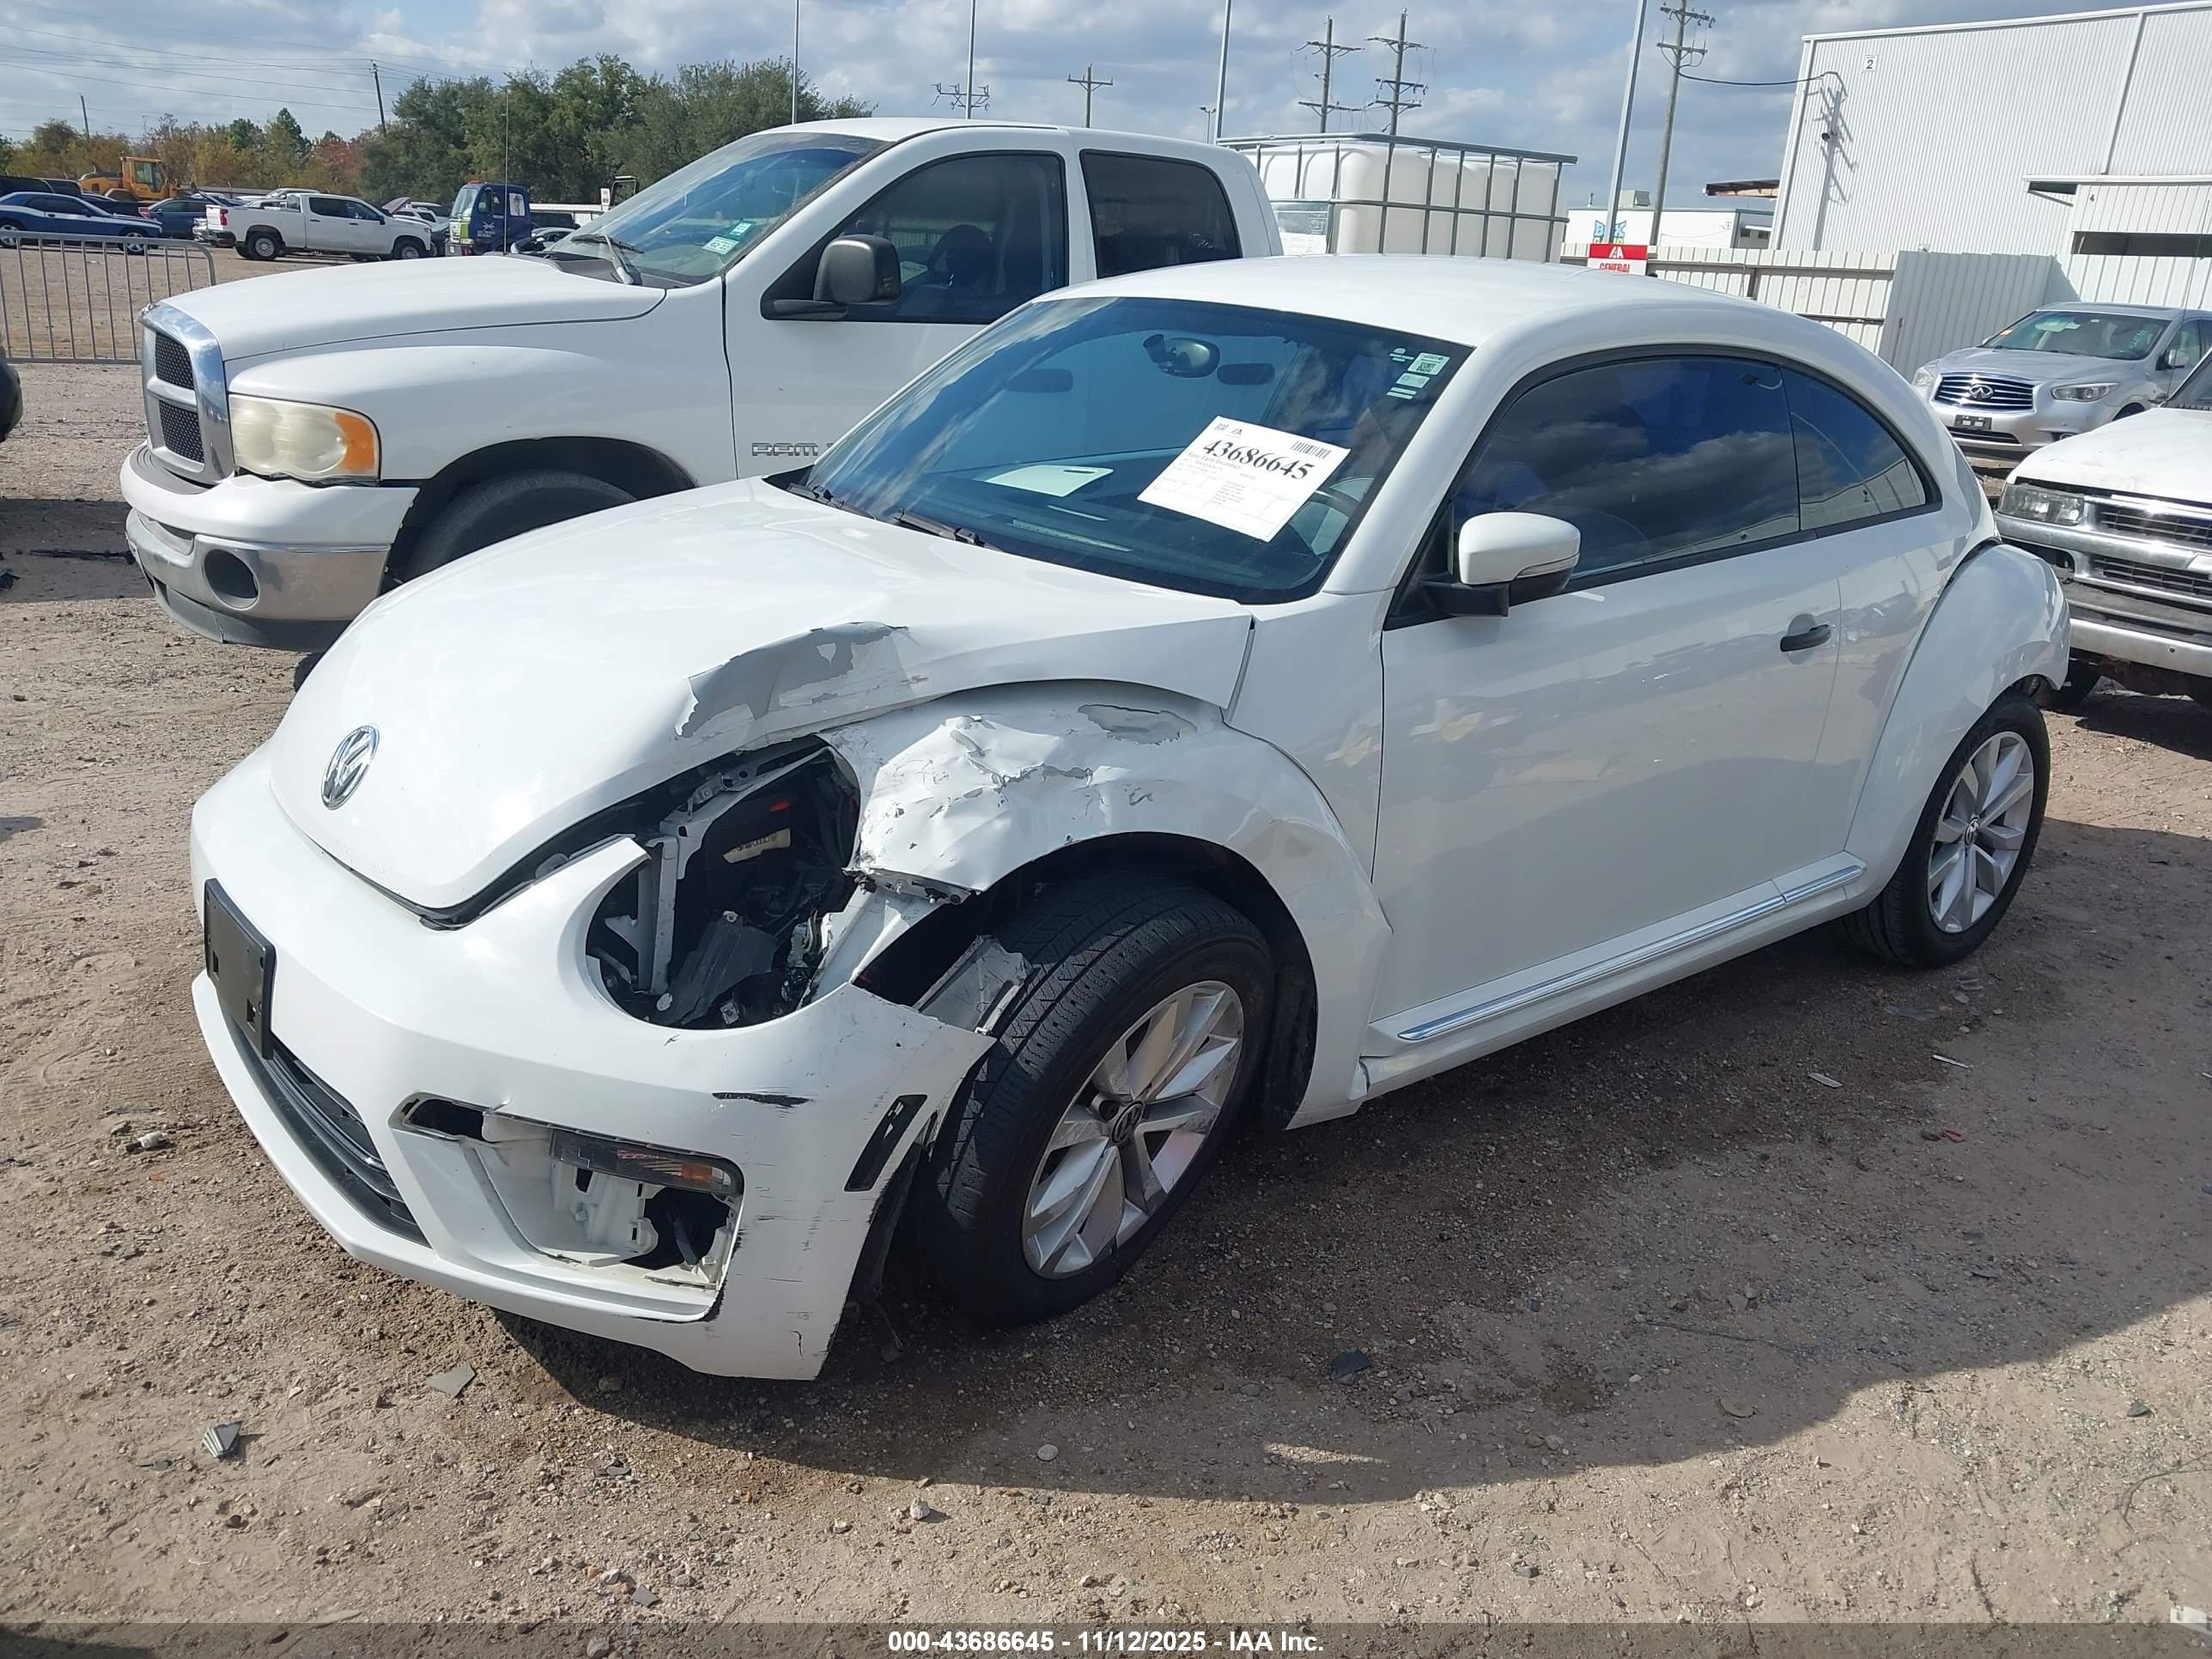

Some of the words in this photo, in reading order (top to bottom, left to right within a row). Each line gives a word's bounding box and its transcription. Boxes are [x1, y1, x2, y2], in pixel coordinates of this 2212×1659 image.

[1866, 59, 1874, 70] 2
[752, 442, 818, 456] RAM
[1202, 440, 1316, 480] 43686645
